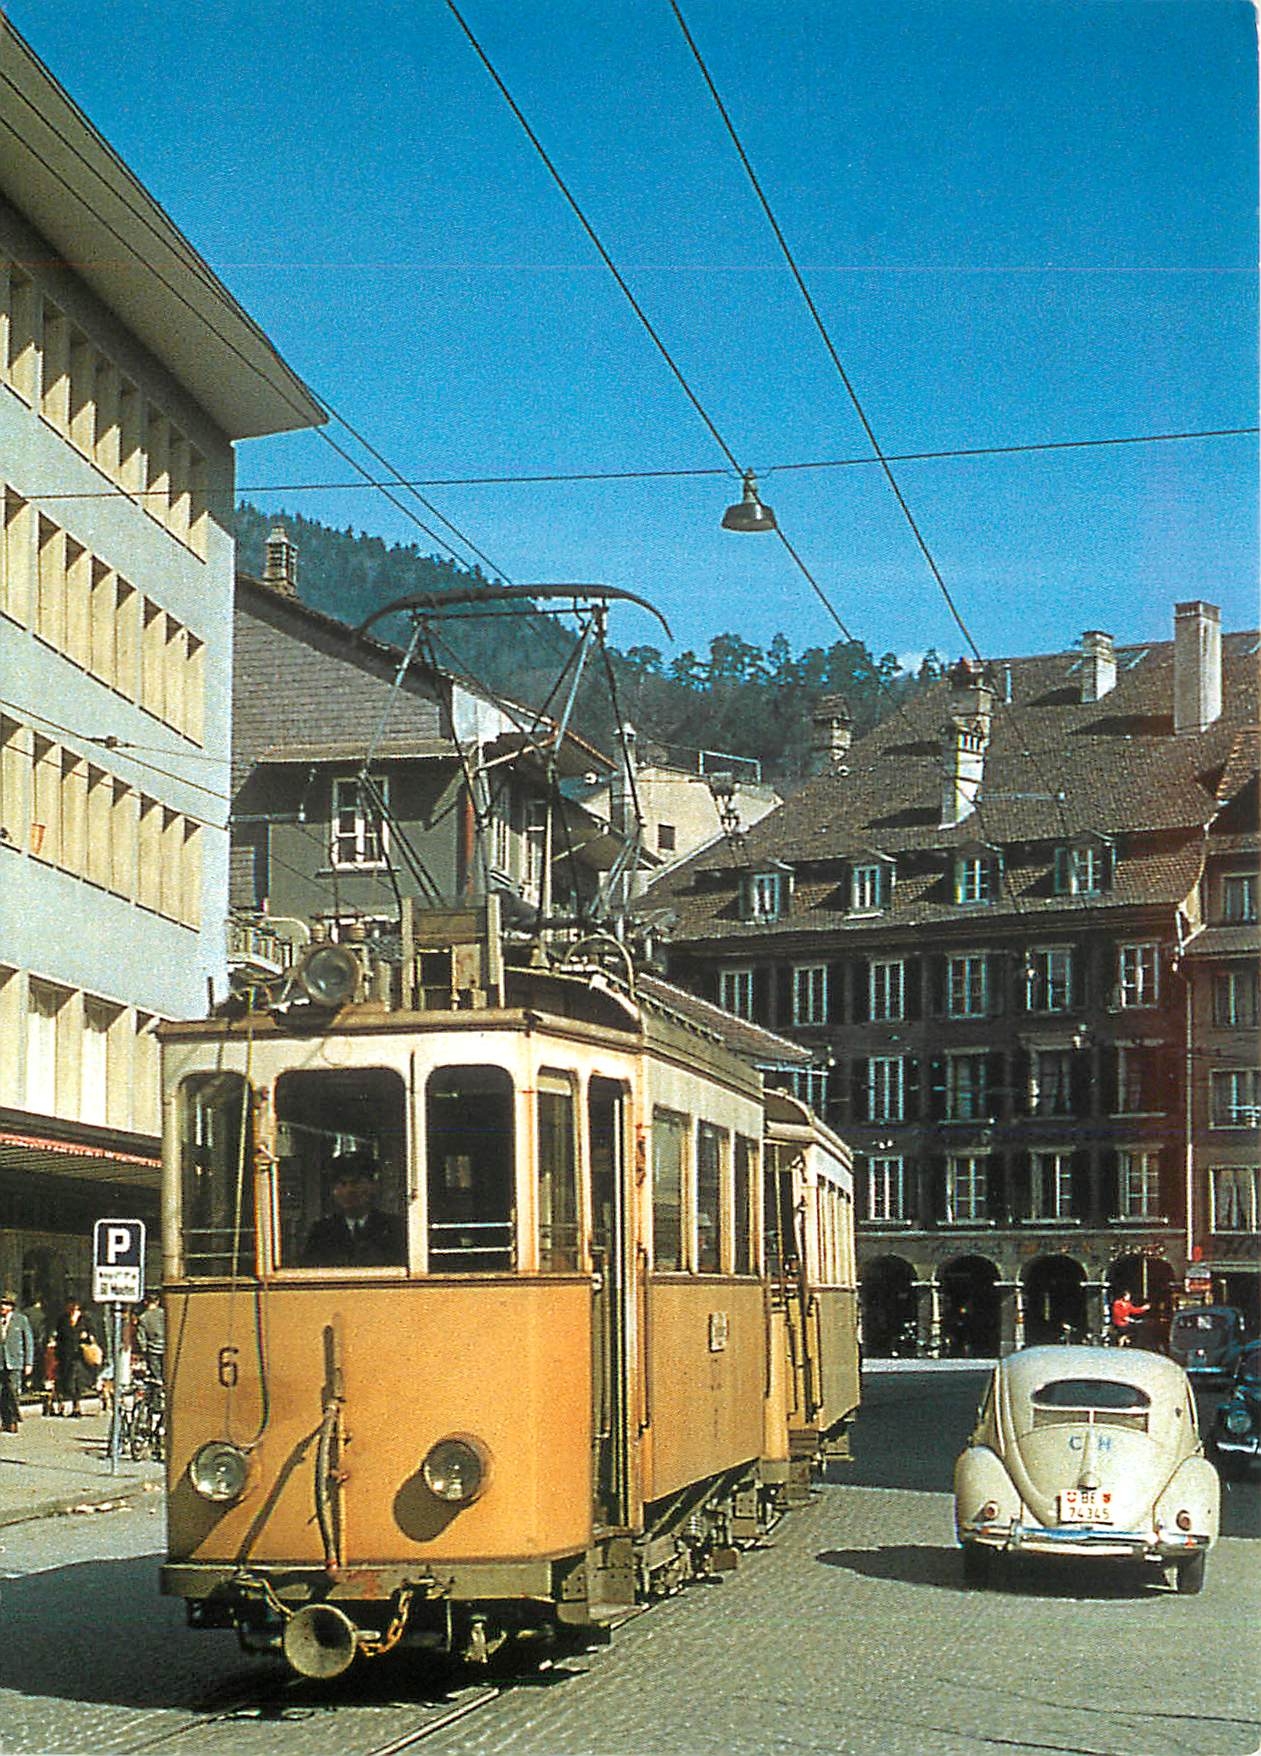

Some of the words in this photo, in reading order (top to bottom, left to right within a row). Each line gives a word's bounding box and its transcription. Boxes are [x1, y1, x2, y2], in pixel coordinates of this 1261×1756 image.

[107, 1228, 130, 1264] P
[218, 1347, 239, 1388] 6
[1068, 1506, 1110, 1520] 74345
